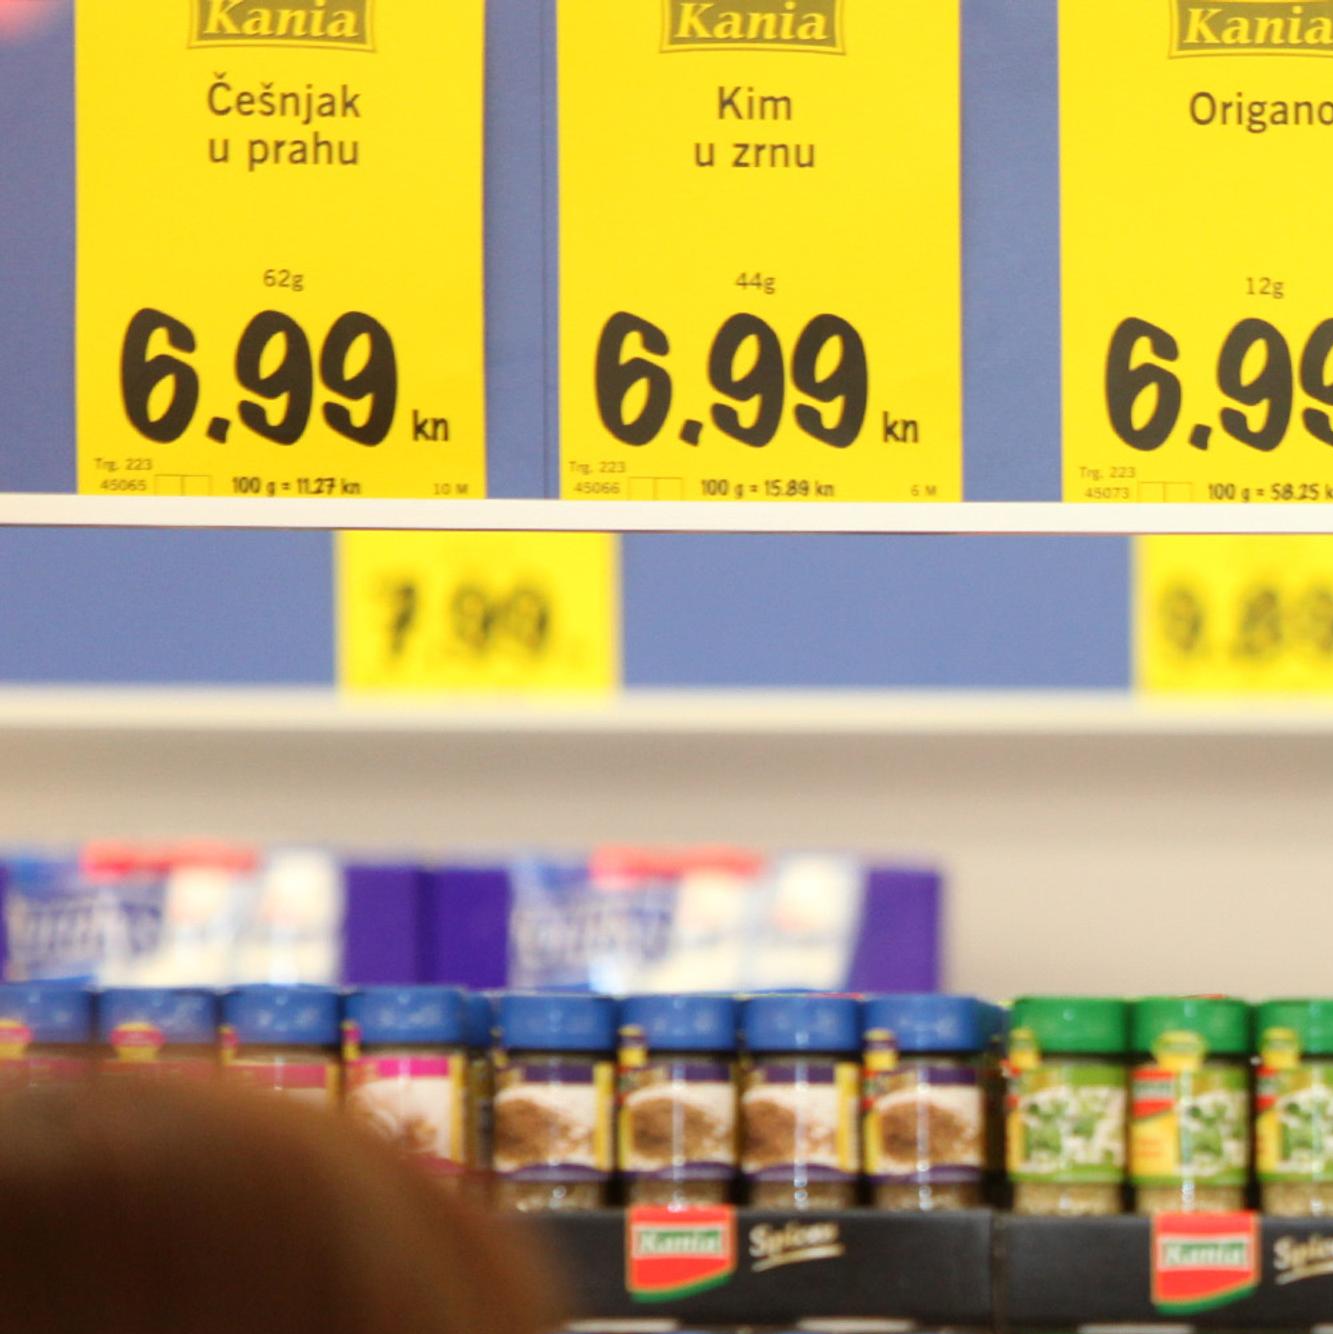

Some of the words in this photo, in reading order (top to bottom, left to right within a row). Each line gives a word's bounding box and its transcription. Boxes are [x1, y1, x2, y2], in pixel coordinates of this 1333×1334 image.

[204, 0, 359, 39] Kania
[675, 0, 828, 42] Kania
[208, 73, 360, 125] Češnjak
[719, 87, 791, 120] Kim
[209, 139, 228, 163] u
[249, 131, 358, 171] prahu
[696, 143, 714, 167] u
[733, 143, 814, 168] zrnu
[264, 269, 303, 292] 62g
[736, 273, 775, 295] 44g
[1247, 277, 1284, 299] 12g
[121, 308, 398, 447] 6.99
[413, 410, 448, 441] kn
[595, 311, 868, 448] 6.99
[883, 411, 918, 442] kn
[93, 457, 120, 473] Trg.
[124, 457, 153, 471] 223
[567, 460, 593, 476] Trg.
[598, 460, 627, 474] 223
[1079, 465, 1104, 482] Trg.
[1108, 465, 1137, 479] 223
[99, 478, 148, 492] 45065
[232, 476, 262, 494] 100
[296, 476, 337, 495] 11.27
[340, 478, 361, 495] kn
[433, 482, 452, 496] 10
[455, 483, 469, 495] M
[573, 481, 621, 495] 45066
[700, 478, 730, 497] 100
[764, 478, 810, 497] 15.89
[814, 481, 835, 497] kn
[910, 484, 920, 497] 6
[924, 484, 938, 497] M
[1084, 486, 1130, 500] 45073
[1207, 482, 1237, 501] 100
[1271, 482, 1320, 501] 58.25
